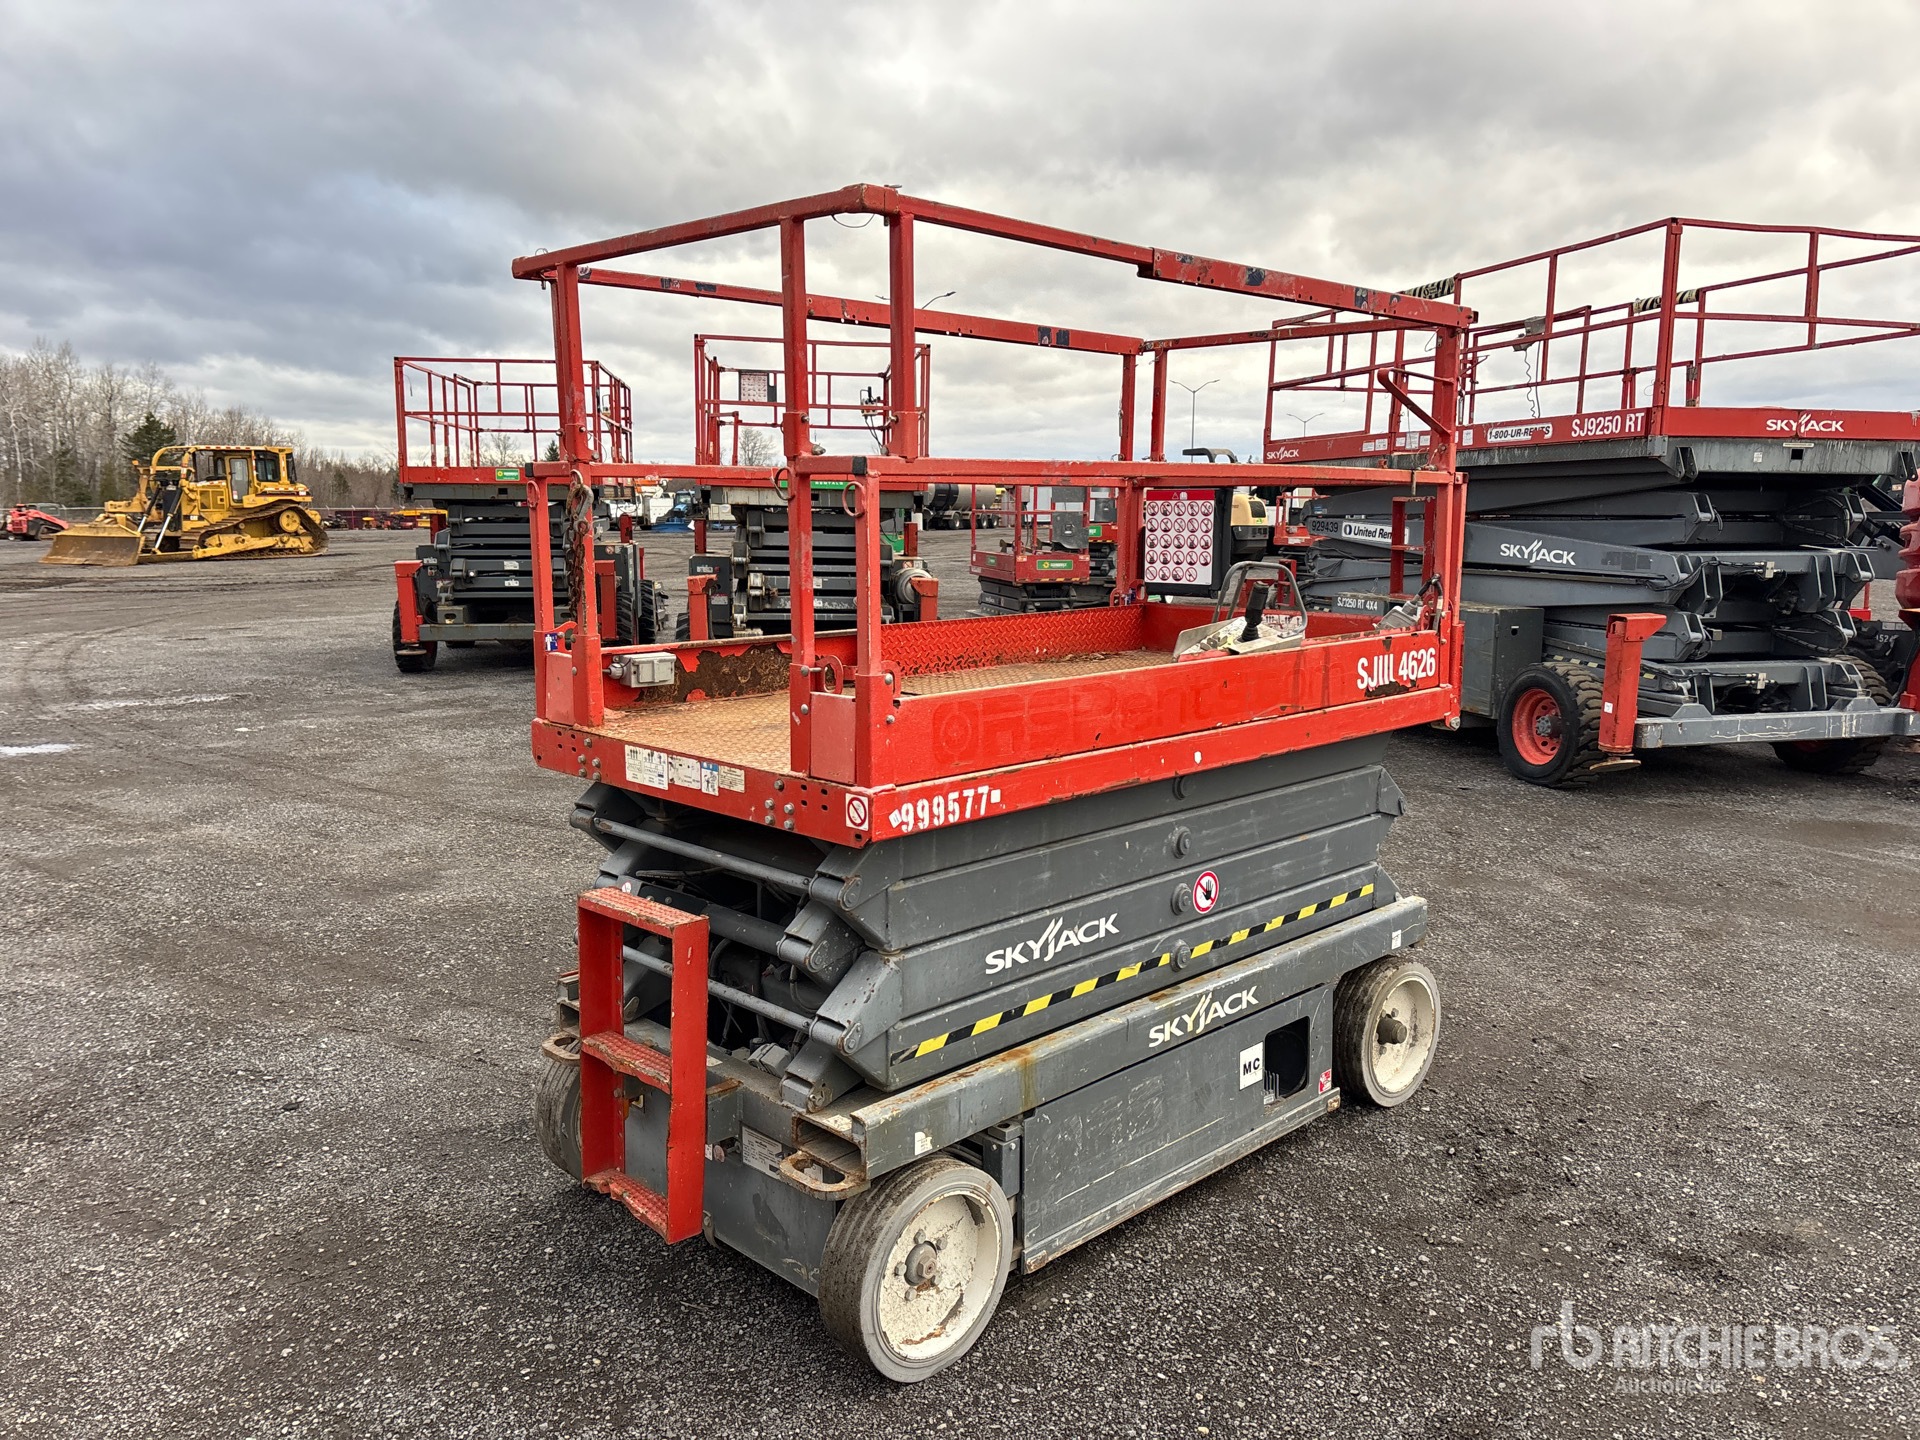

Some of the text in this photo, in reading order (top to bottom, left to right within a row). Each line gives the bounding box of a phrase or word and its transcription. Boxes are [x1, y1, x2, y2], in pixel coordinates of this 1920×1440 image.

[1571, 413, 1645, 437] SJ9250 RT
[1766, 413, 1844, 433] SKYJACK
[1266, 447, 1299, 460] SKYJACK
[1312, 520, 1339, 533] 929439
[1353, 526, 1376, 538] United
[1500, 539, 1576, 566] SKYJACK
[1398, 647, 1436, 681] 4626
[901, 785, 990, 833] 999577
[985, 913, 1119, 975] SKYJACK
[1149, 986, 1259, 1048] SKYJACK
